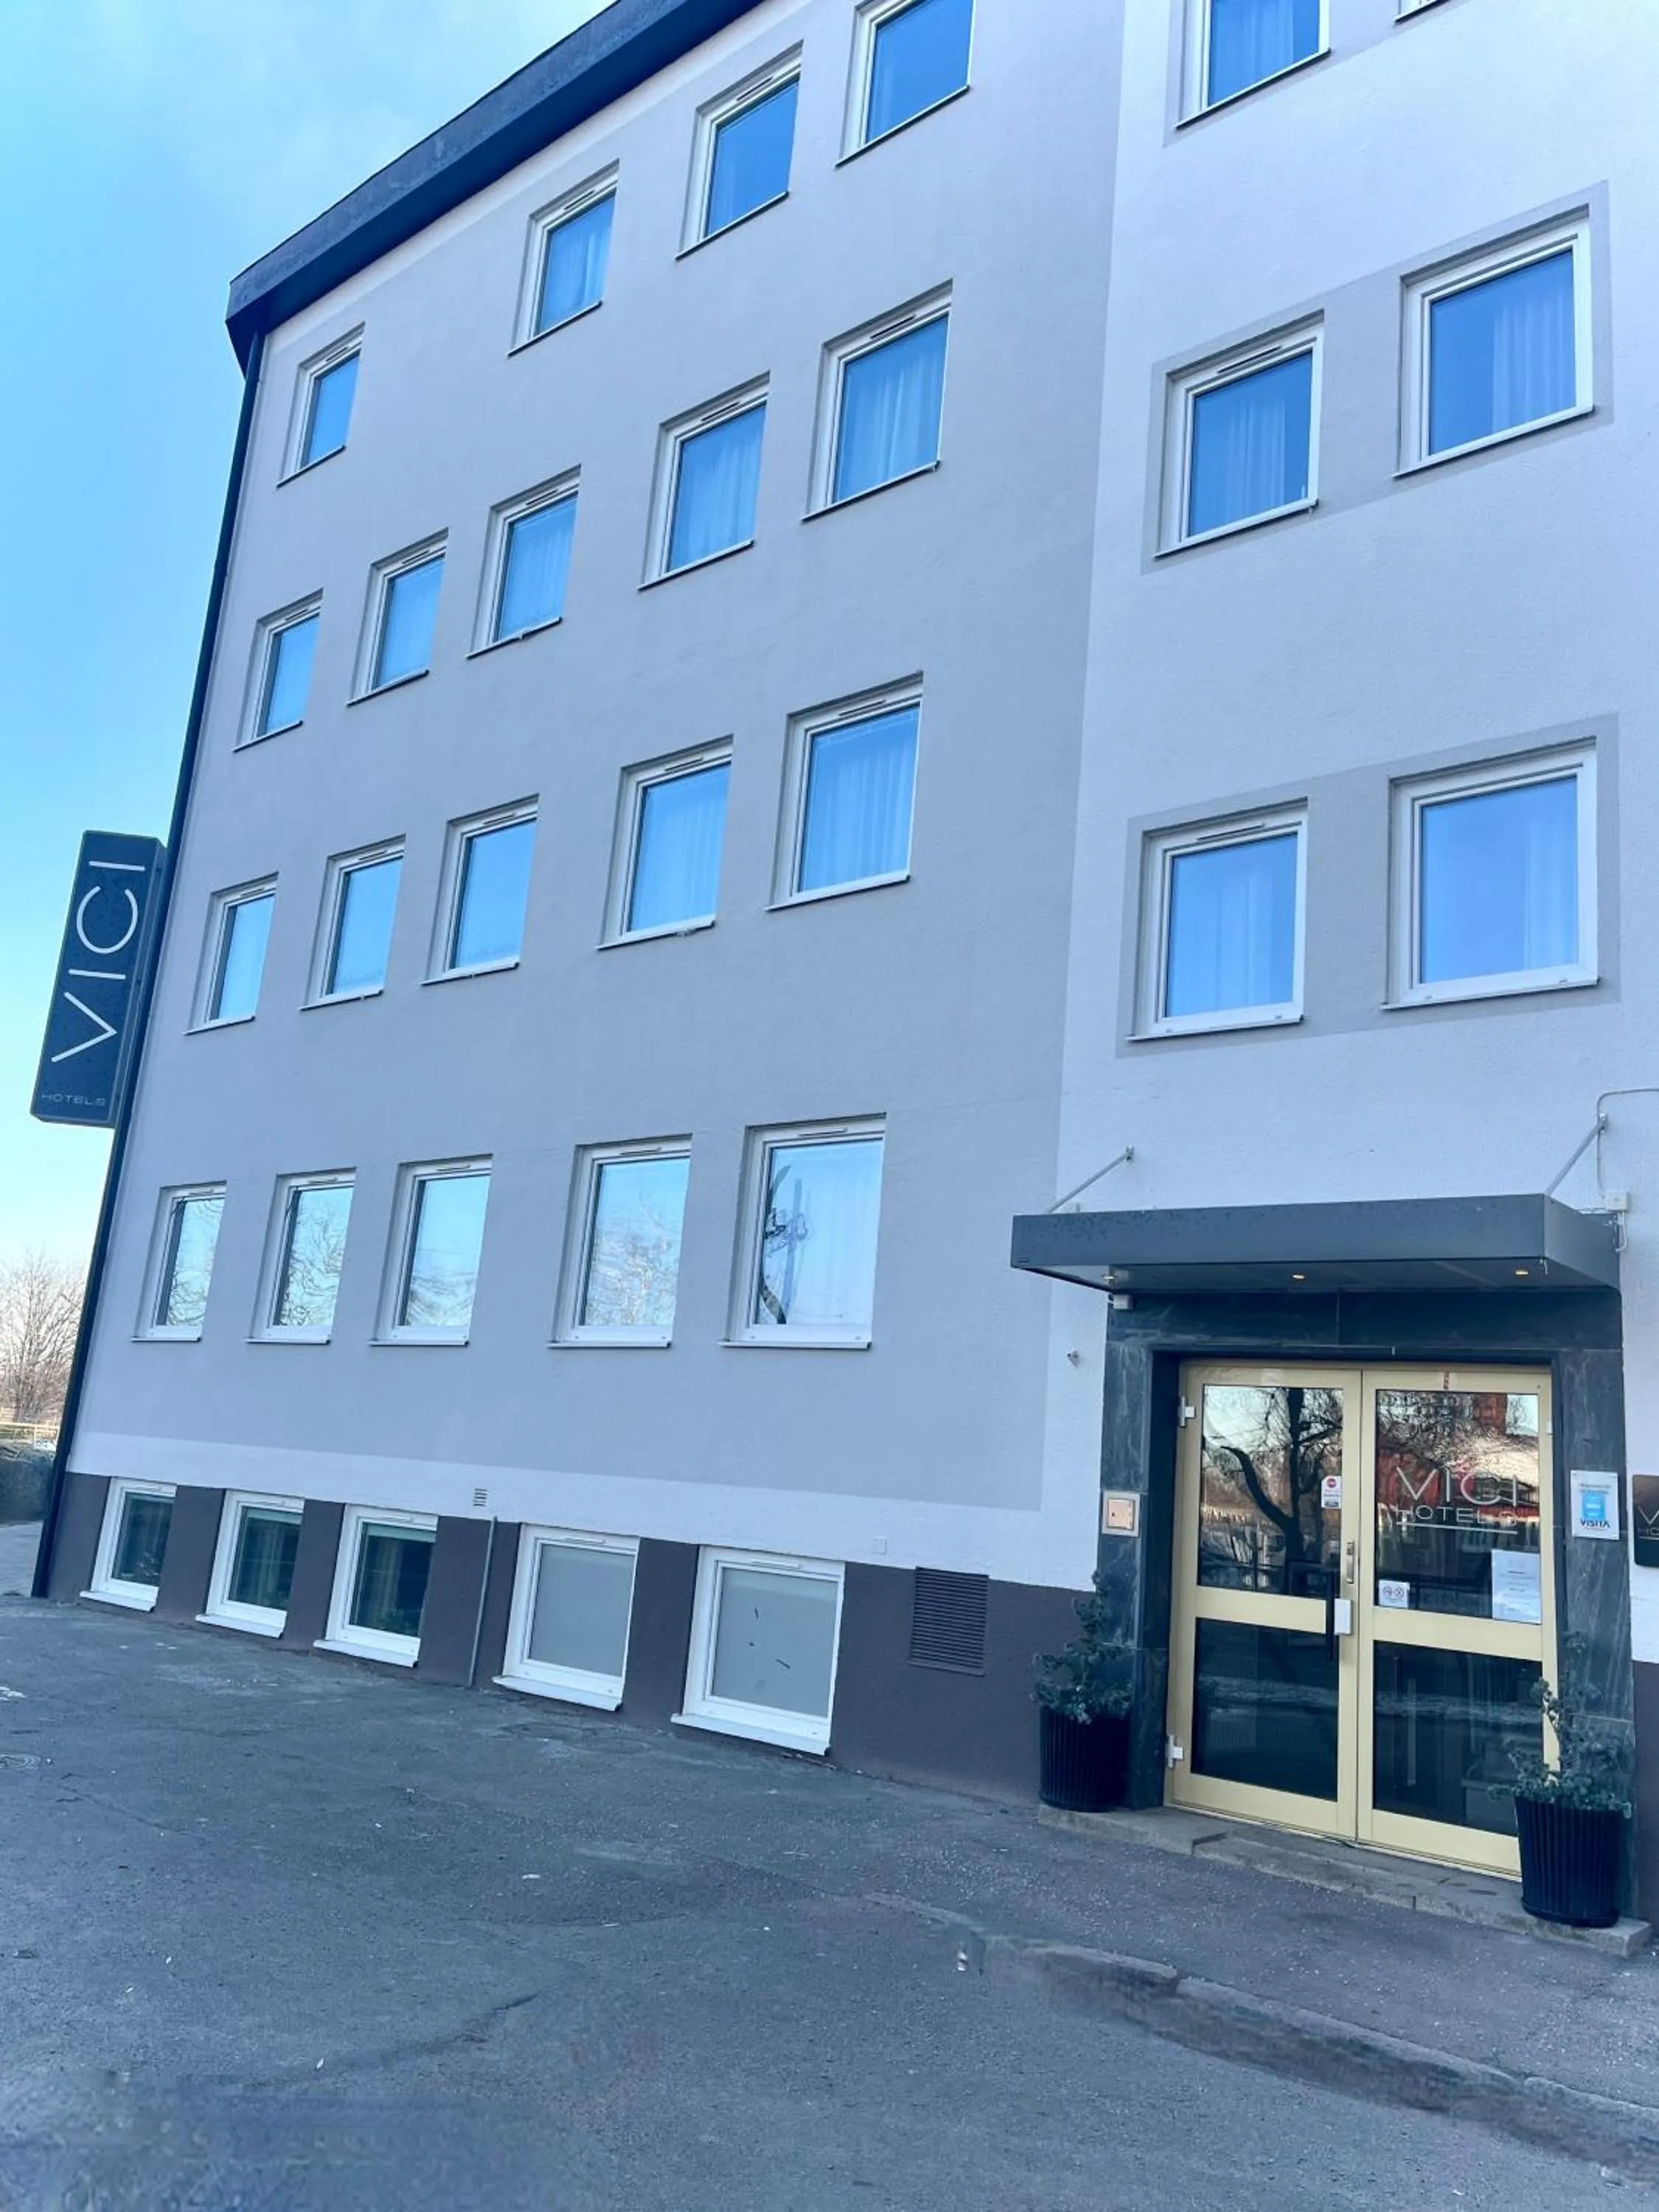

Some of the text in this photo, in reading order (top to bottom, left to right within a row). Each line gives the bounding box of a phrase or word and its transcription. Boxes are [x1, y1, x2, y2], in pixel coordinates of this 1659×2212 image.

[51, 860, 146, 1062] VICI
[41, 1092, 106, 1106] HOTELS
[1396, 1466, 1517, 1506] VICI
[1395, 1504, 1517, 1527] HOTELS
[1580, 1518, 1610, 1528] VISITA
